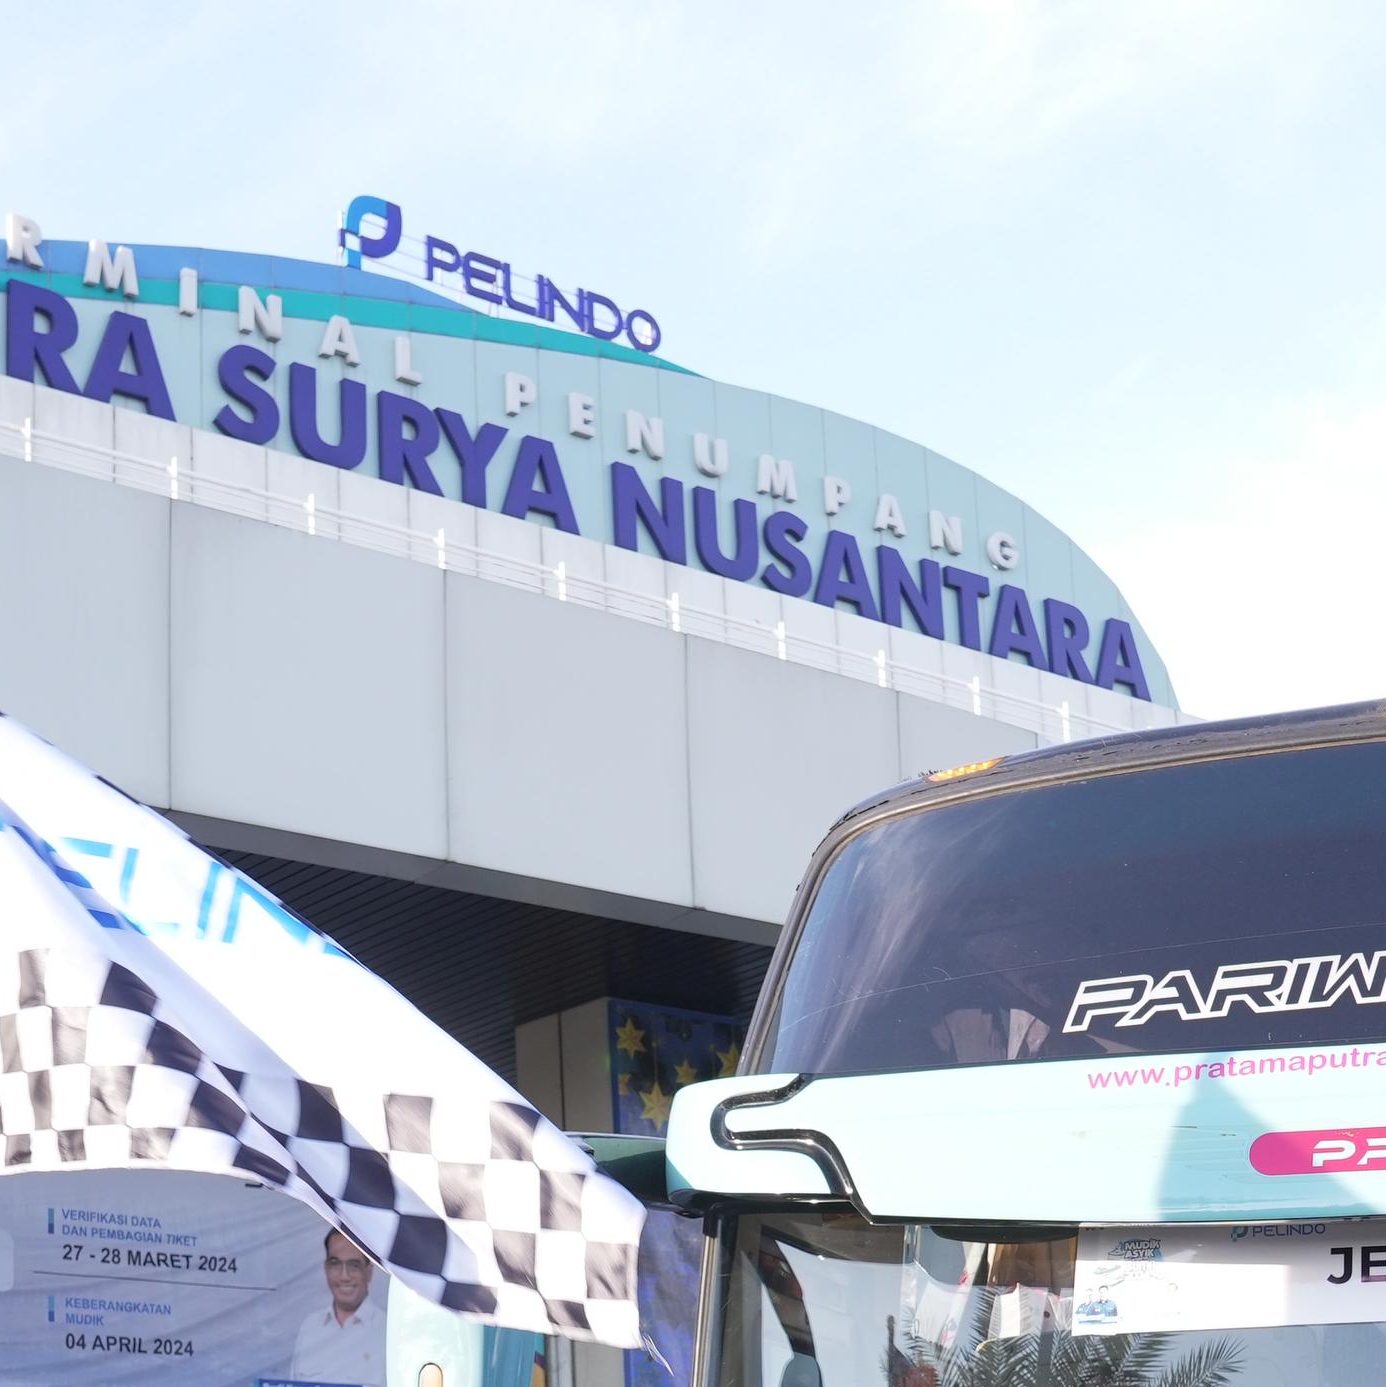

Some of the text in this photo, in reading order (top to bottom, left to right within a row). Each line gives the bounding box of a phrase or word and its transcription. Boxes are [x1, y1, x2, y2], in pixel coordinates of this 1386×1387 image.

[425, 234, 662, 353] PELINDO
[505, 371, 1019, 571] PENUMPANG
[214, 344, 580, 536] SURYA
[612, 462, 1151, 702] NUSANTARA
[62, 1209, 162, 1229] VERIFIKASI DATA
[62, 1224, 197, 1247] DAN PEMBAGIAN TIKET
[1252, 1223, 1326, 1237] PELINDO
[1124, 1240, 1161, 1250] MUDIK
[1124, 1249, 1155, 1259] ASYIK
[62, 1245, 83, 1261] 27
[100, 1247, 121, 1264] 28
[127, 1251, 193, 1270] MARET
[198, 1256, 237, 1273] 2024
[65, 1297, 172, 1316] KEBERANGKATAN
[65, 1314, 104, 1326] MUDIK
[65, 1333, 194, 1357] 04 APRIL 2024
